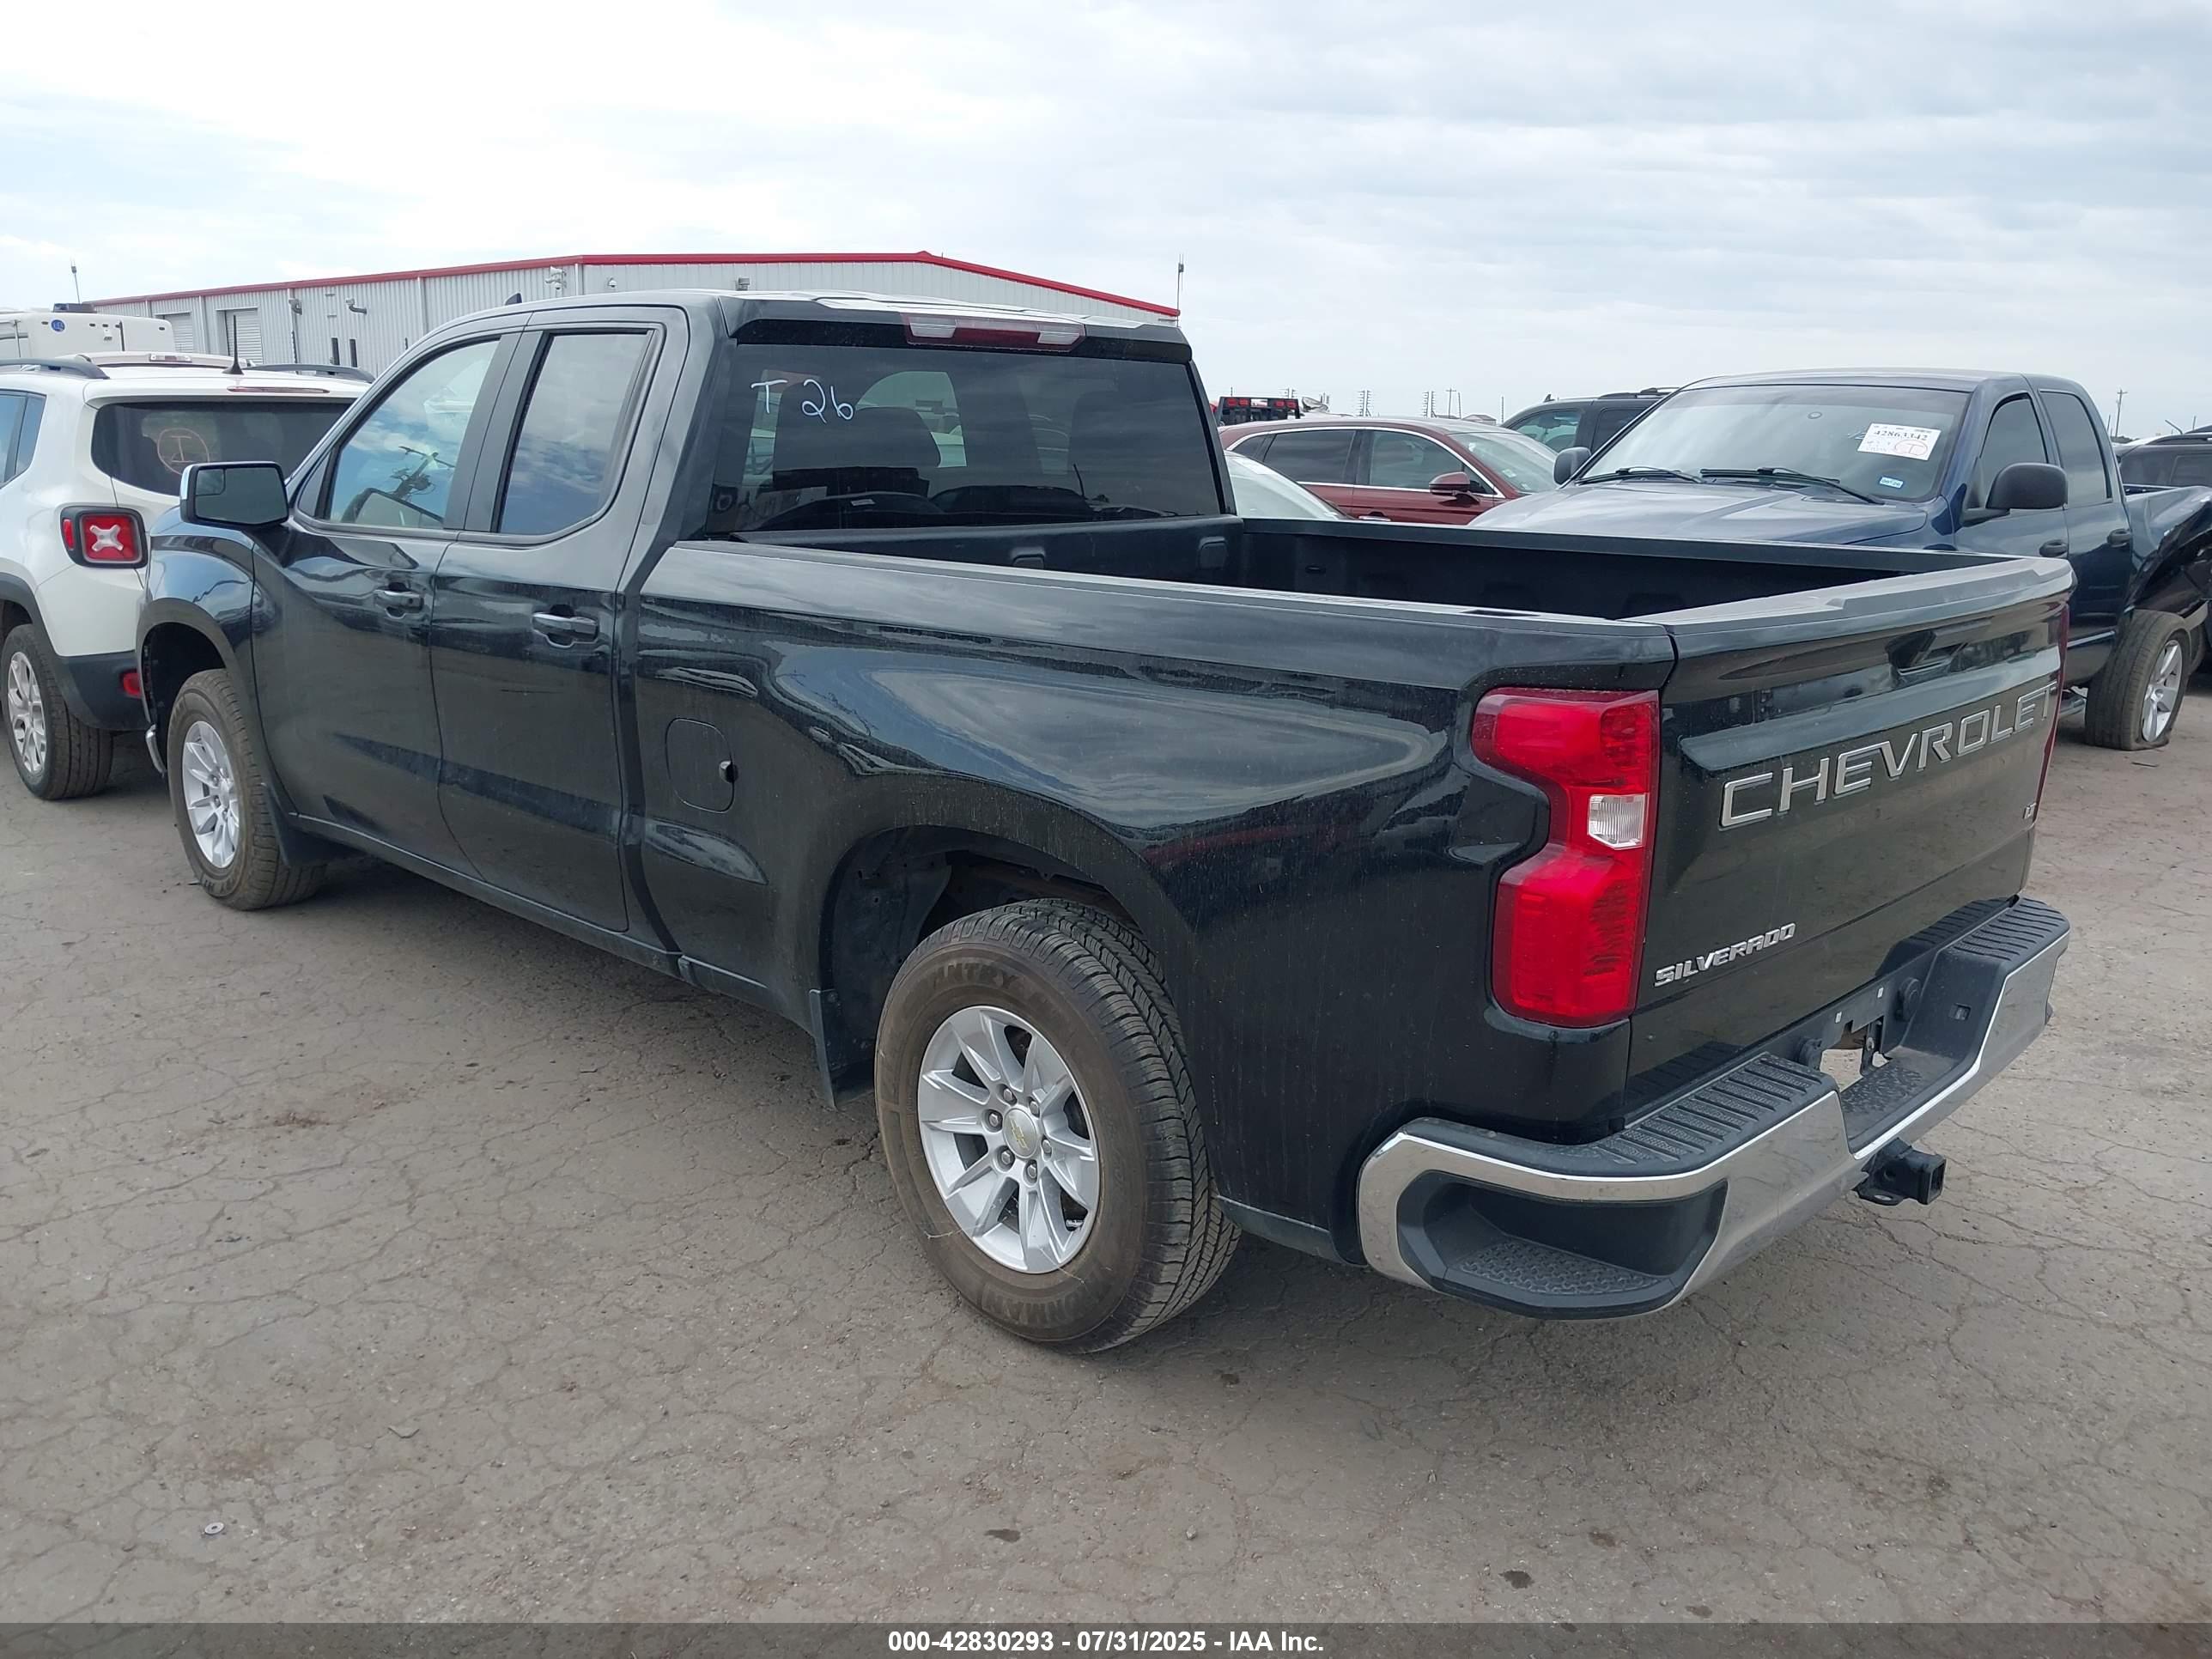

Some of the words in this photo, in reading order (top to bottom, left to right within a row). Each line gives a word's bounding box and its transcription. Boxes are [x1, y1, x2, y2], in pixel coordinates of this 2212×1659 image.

[750, 379, 788, 414] T
[801, 379, 854, 423] 26
[1719, 681, 2057, 829] CHEVROLET
[1654, 922, 1796, 987] SILVERADO
